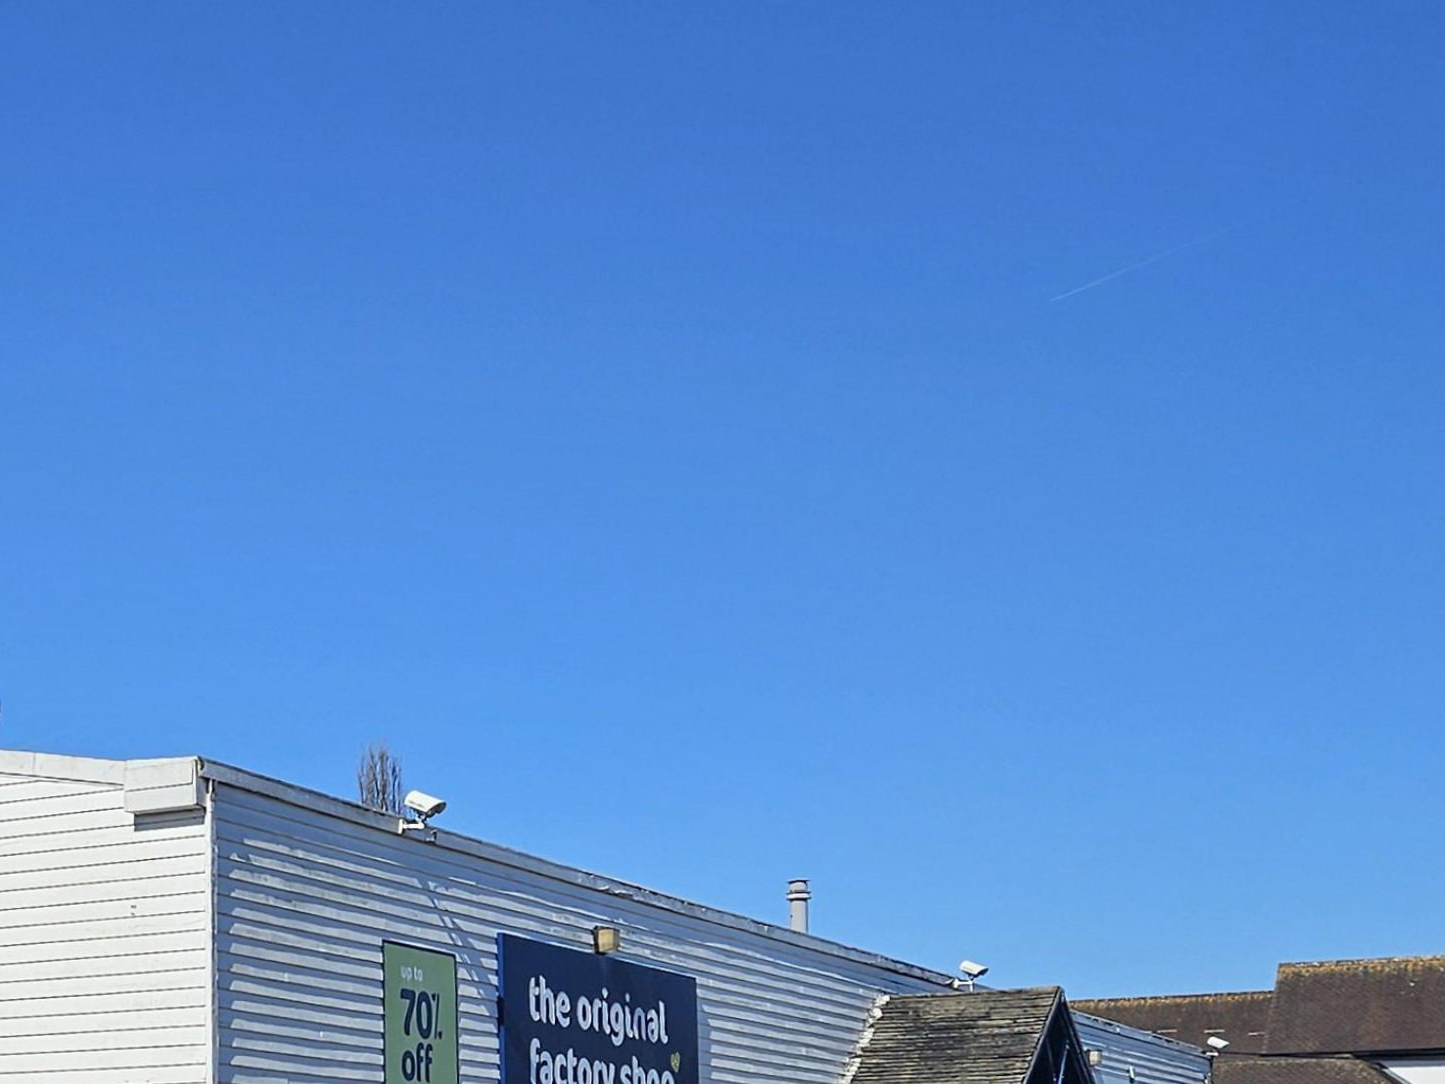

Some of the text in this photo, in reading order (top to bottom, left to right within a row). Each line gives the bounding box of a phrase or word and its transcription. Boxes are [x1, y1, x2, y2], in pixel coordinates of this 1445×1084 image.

[400, 966, 424, 982] up to
[400, 987, 443, 1040] 70%
[528, 975, 669, 1046] the original
[401, 1042, 433, 1084] off
